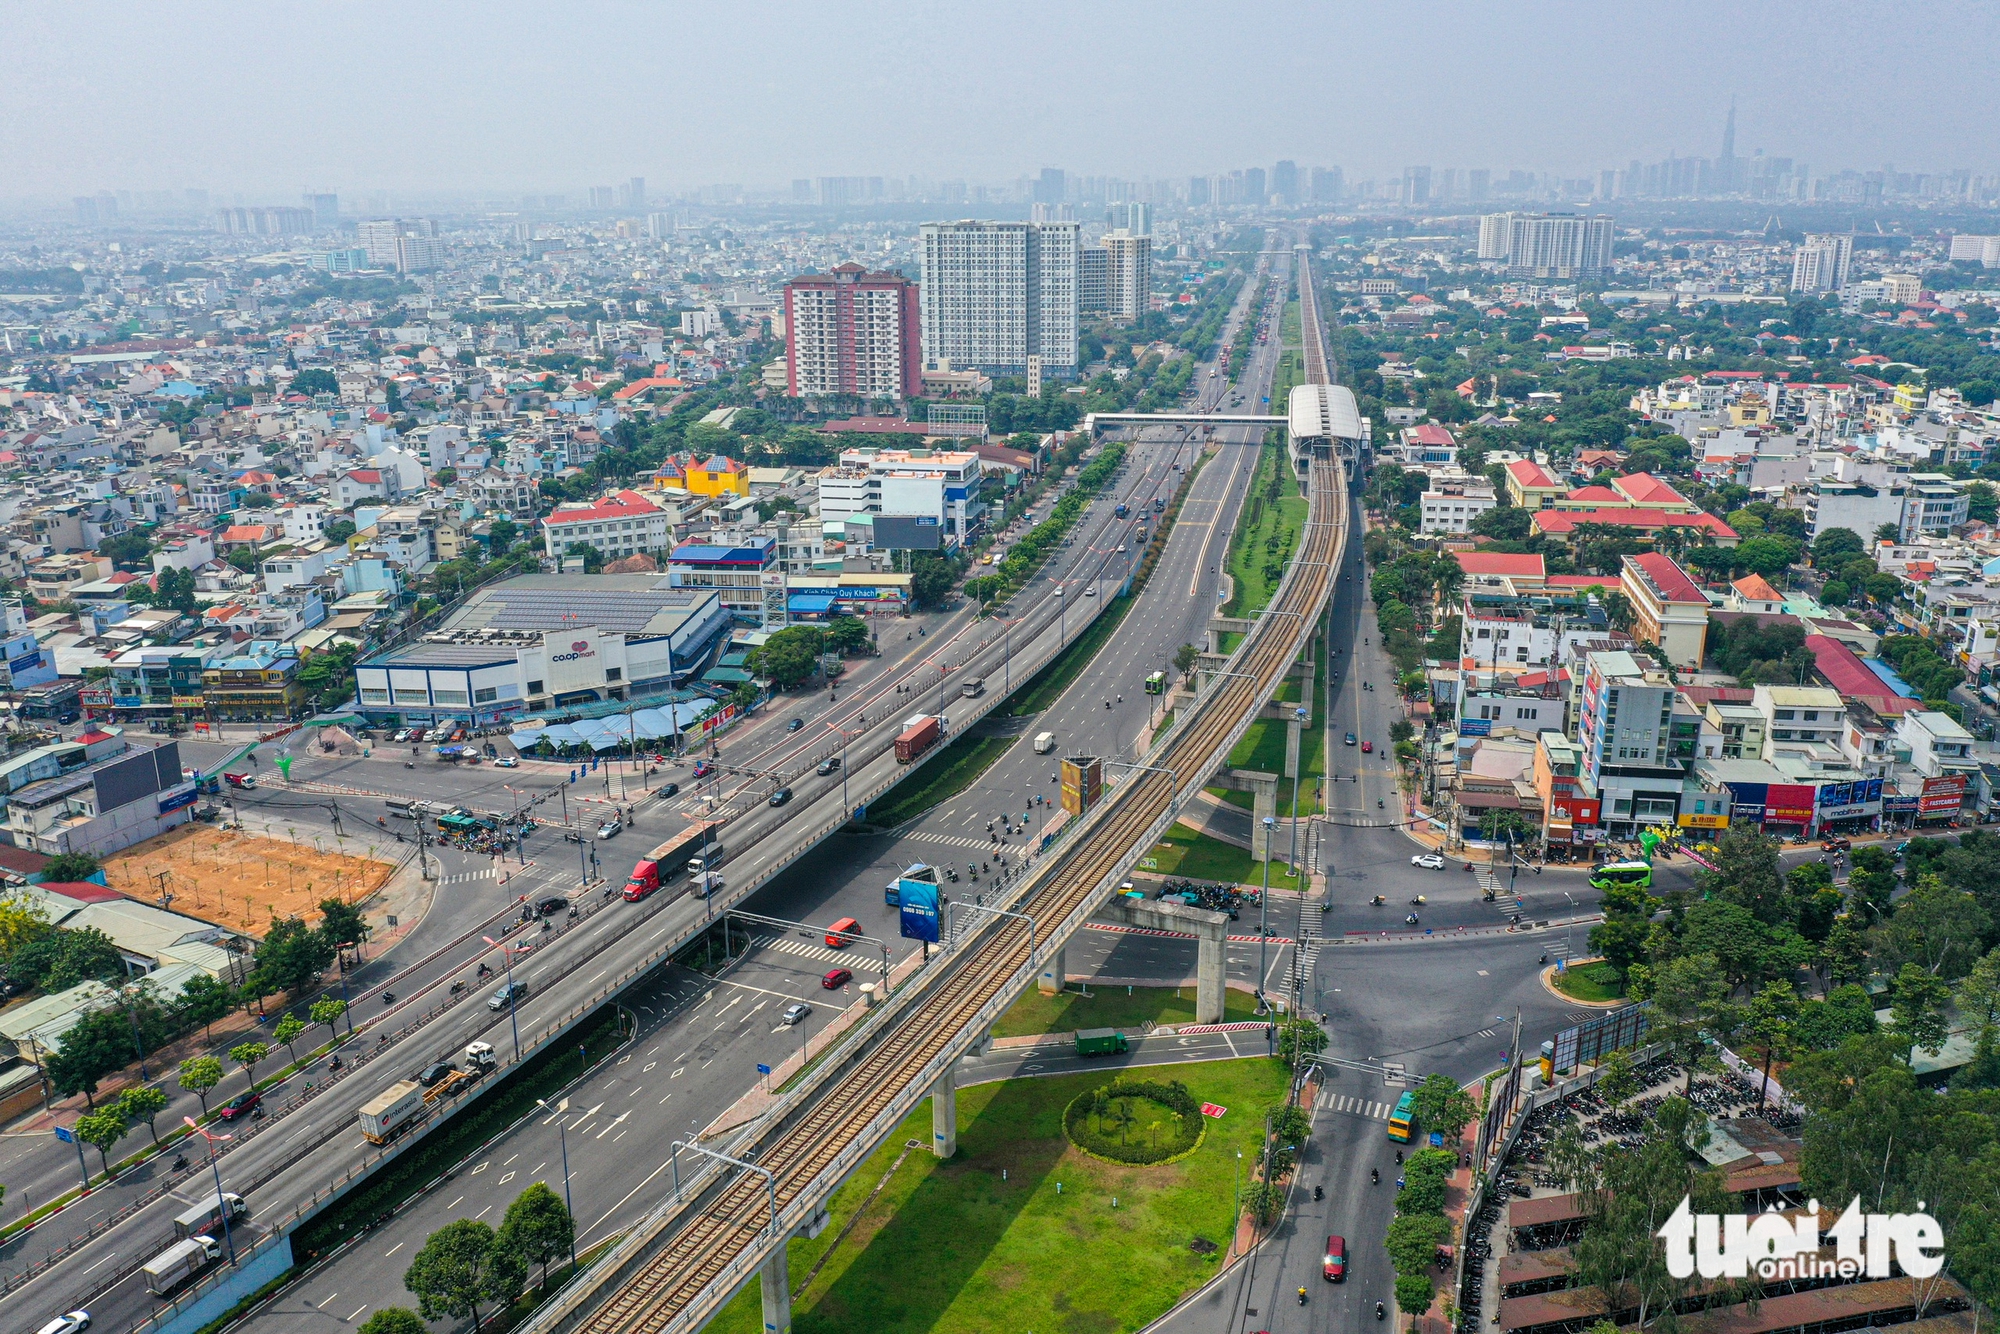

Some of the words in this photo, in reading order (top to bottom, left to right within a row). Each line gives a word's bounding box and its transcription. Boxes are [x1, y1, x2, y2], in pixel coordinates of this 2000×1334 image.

[839, 589, 852, 598] Quý
[854, 588, 875, 598] Khách
[1831, 807, 1864, 816] mobifone
[390, 1097, 417, 1119] Interasia
